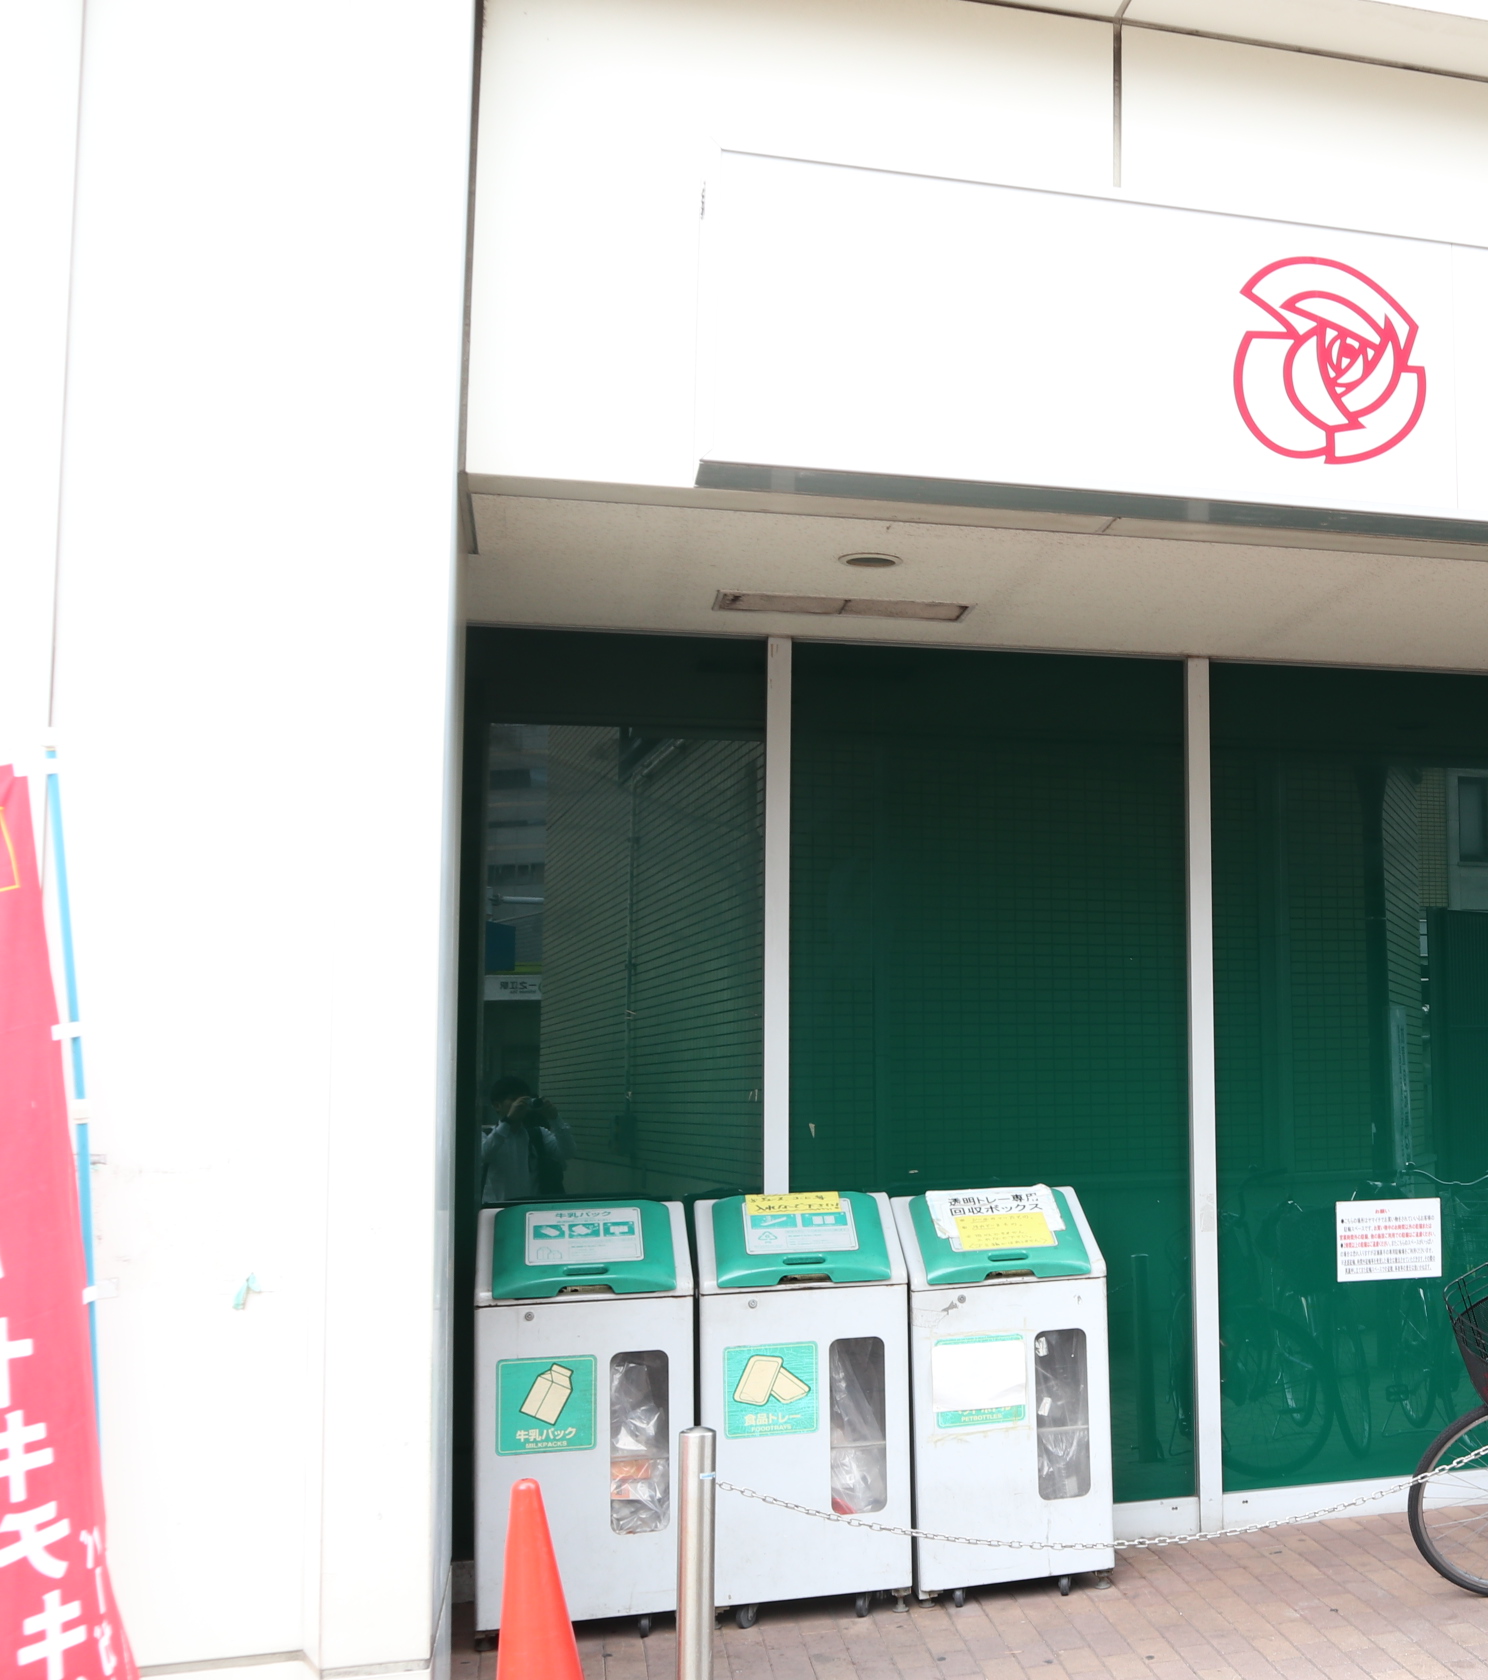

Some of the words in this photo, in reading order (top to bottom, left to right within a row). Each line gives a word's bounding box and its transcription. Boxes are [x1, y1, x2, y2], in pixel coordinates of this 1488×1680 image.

[554, 1210, 612, 1219] 牛乳パック
[744, 1413, 801, 1426] 食品トレー
[515, 1427, 577, 1442] 牛乳パック
[525, 1440, 568, 1448] MILKPACKS
